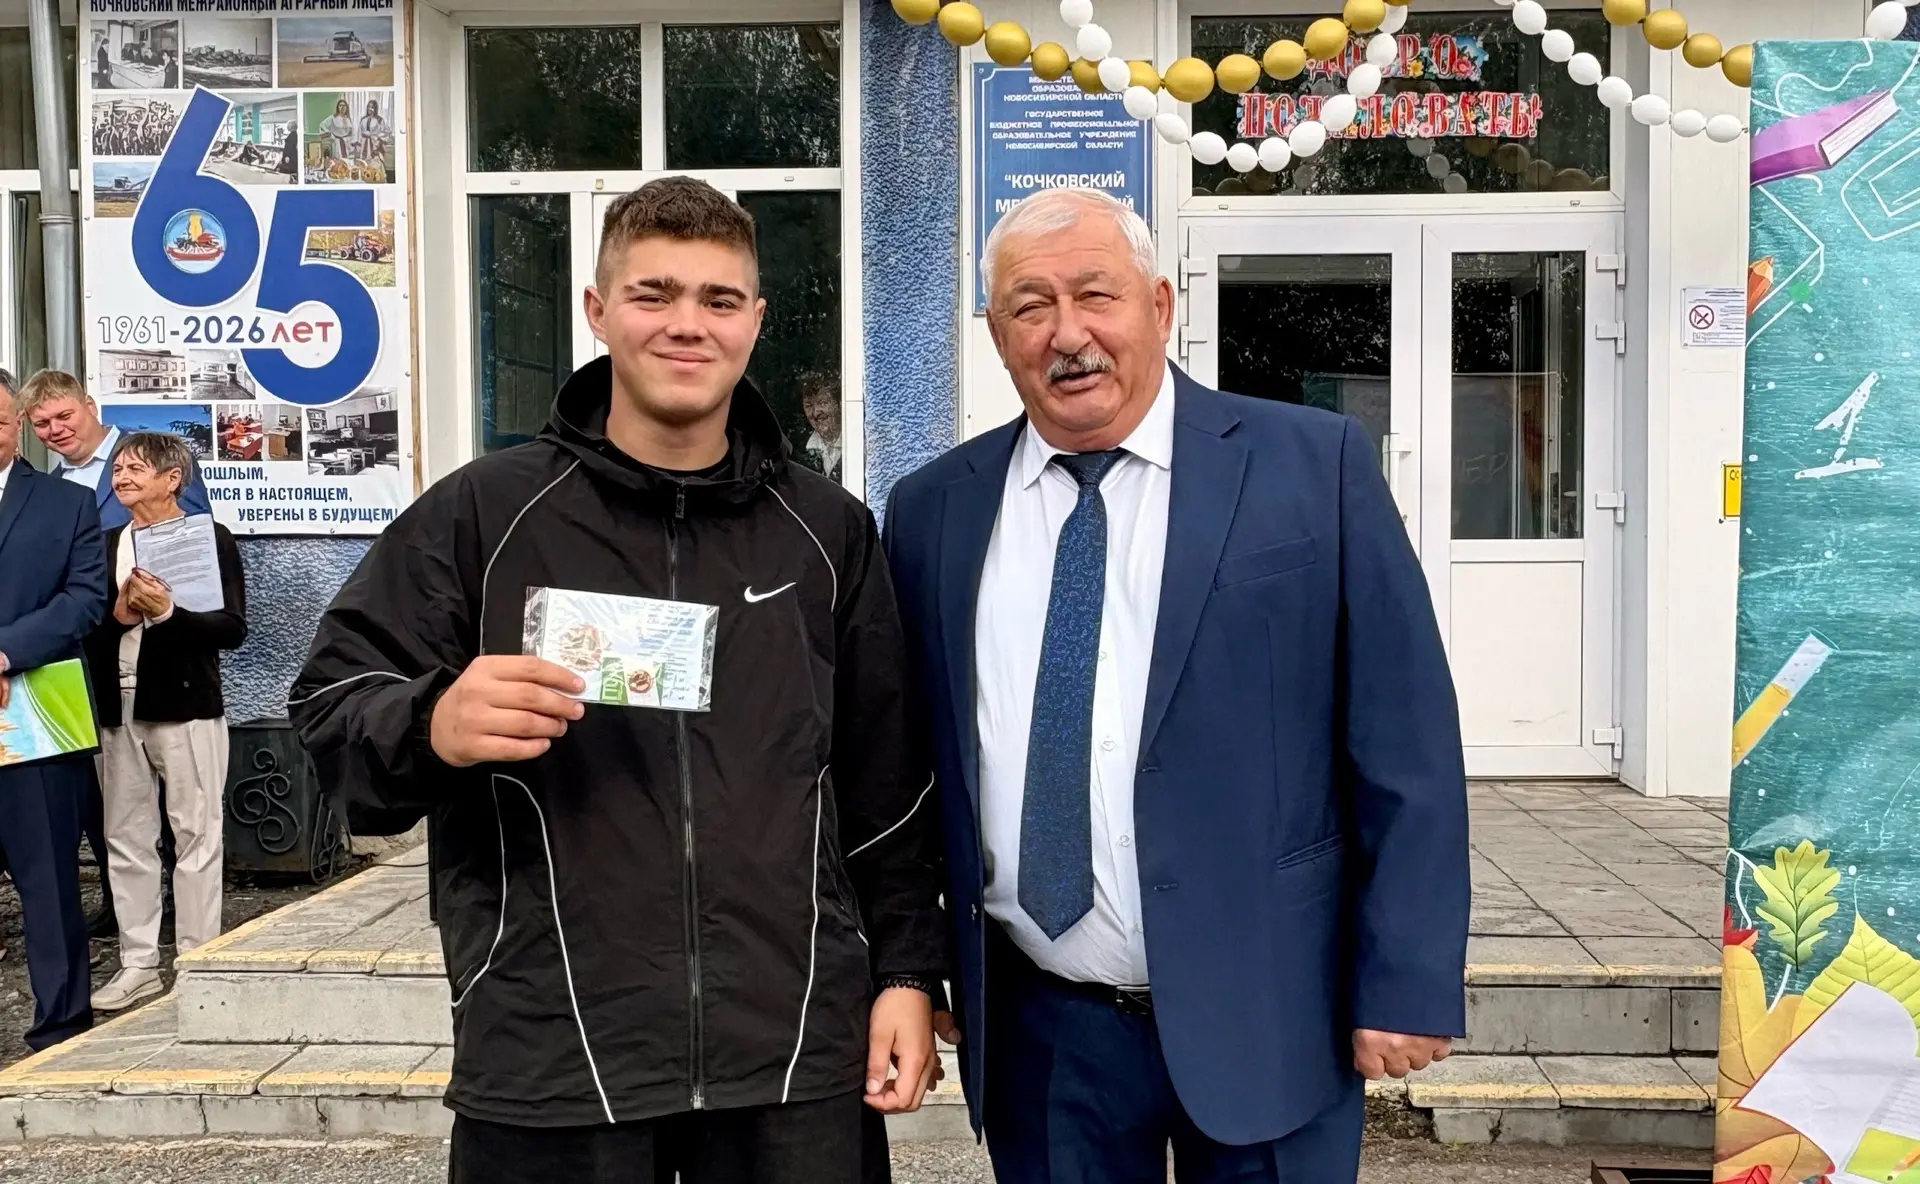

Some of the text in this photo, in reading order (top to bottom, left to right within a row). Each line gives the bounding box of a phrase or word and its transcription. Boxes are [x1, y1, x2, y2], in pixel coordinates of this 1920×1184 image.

[1024, 110, 1104, 118] ГОСУДАРСТВЕННОЕ
[1005, 142, 1078, 150] НОВОСИБИРСКОЙ
[131, 87, 380, 406] 65
[98, 315, 334, 344] 1961-2026 лет
[201, 466, 268, 481] ОШЛЫМ,
[246, 488, 254, 501] В
[259, 487, 353, 503] НАСТОЯЩЕМ,
[238, 508, 398, 523] УВЕРЕНЫ В БУДУЩЕМ!
